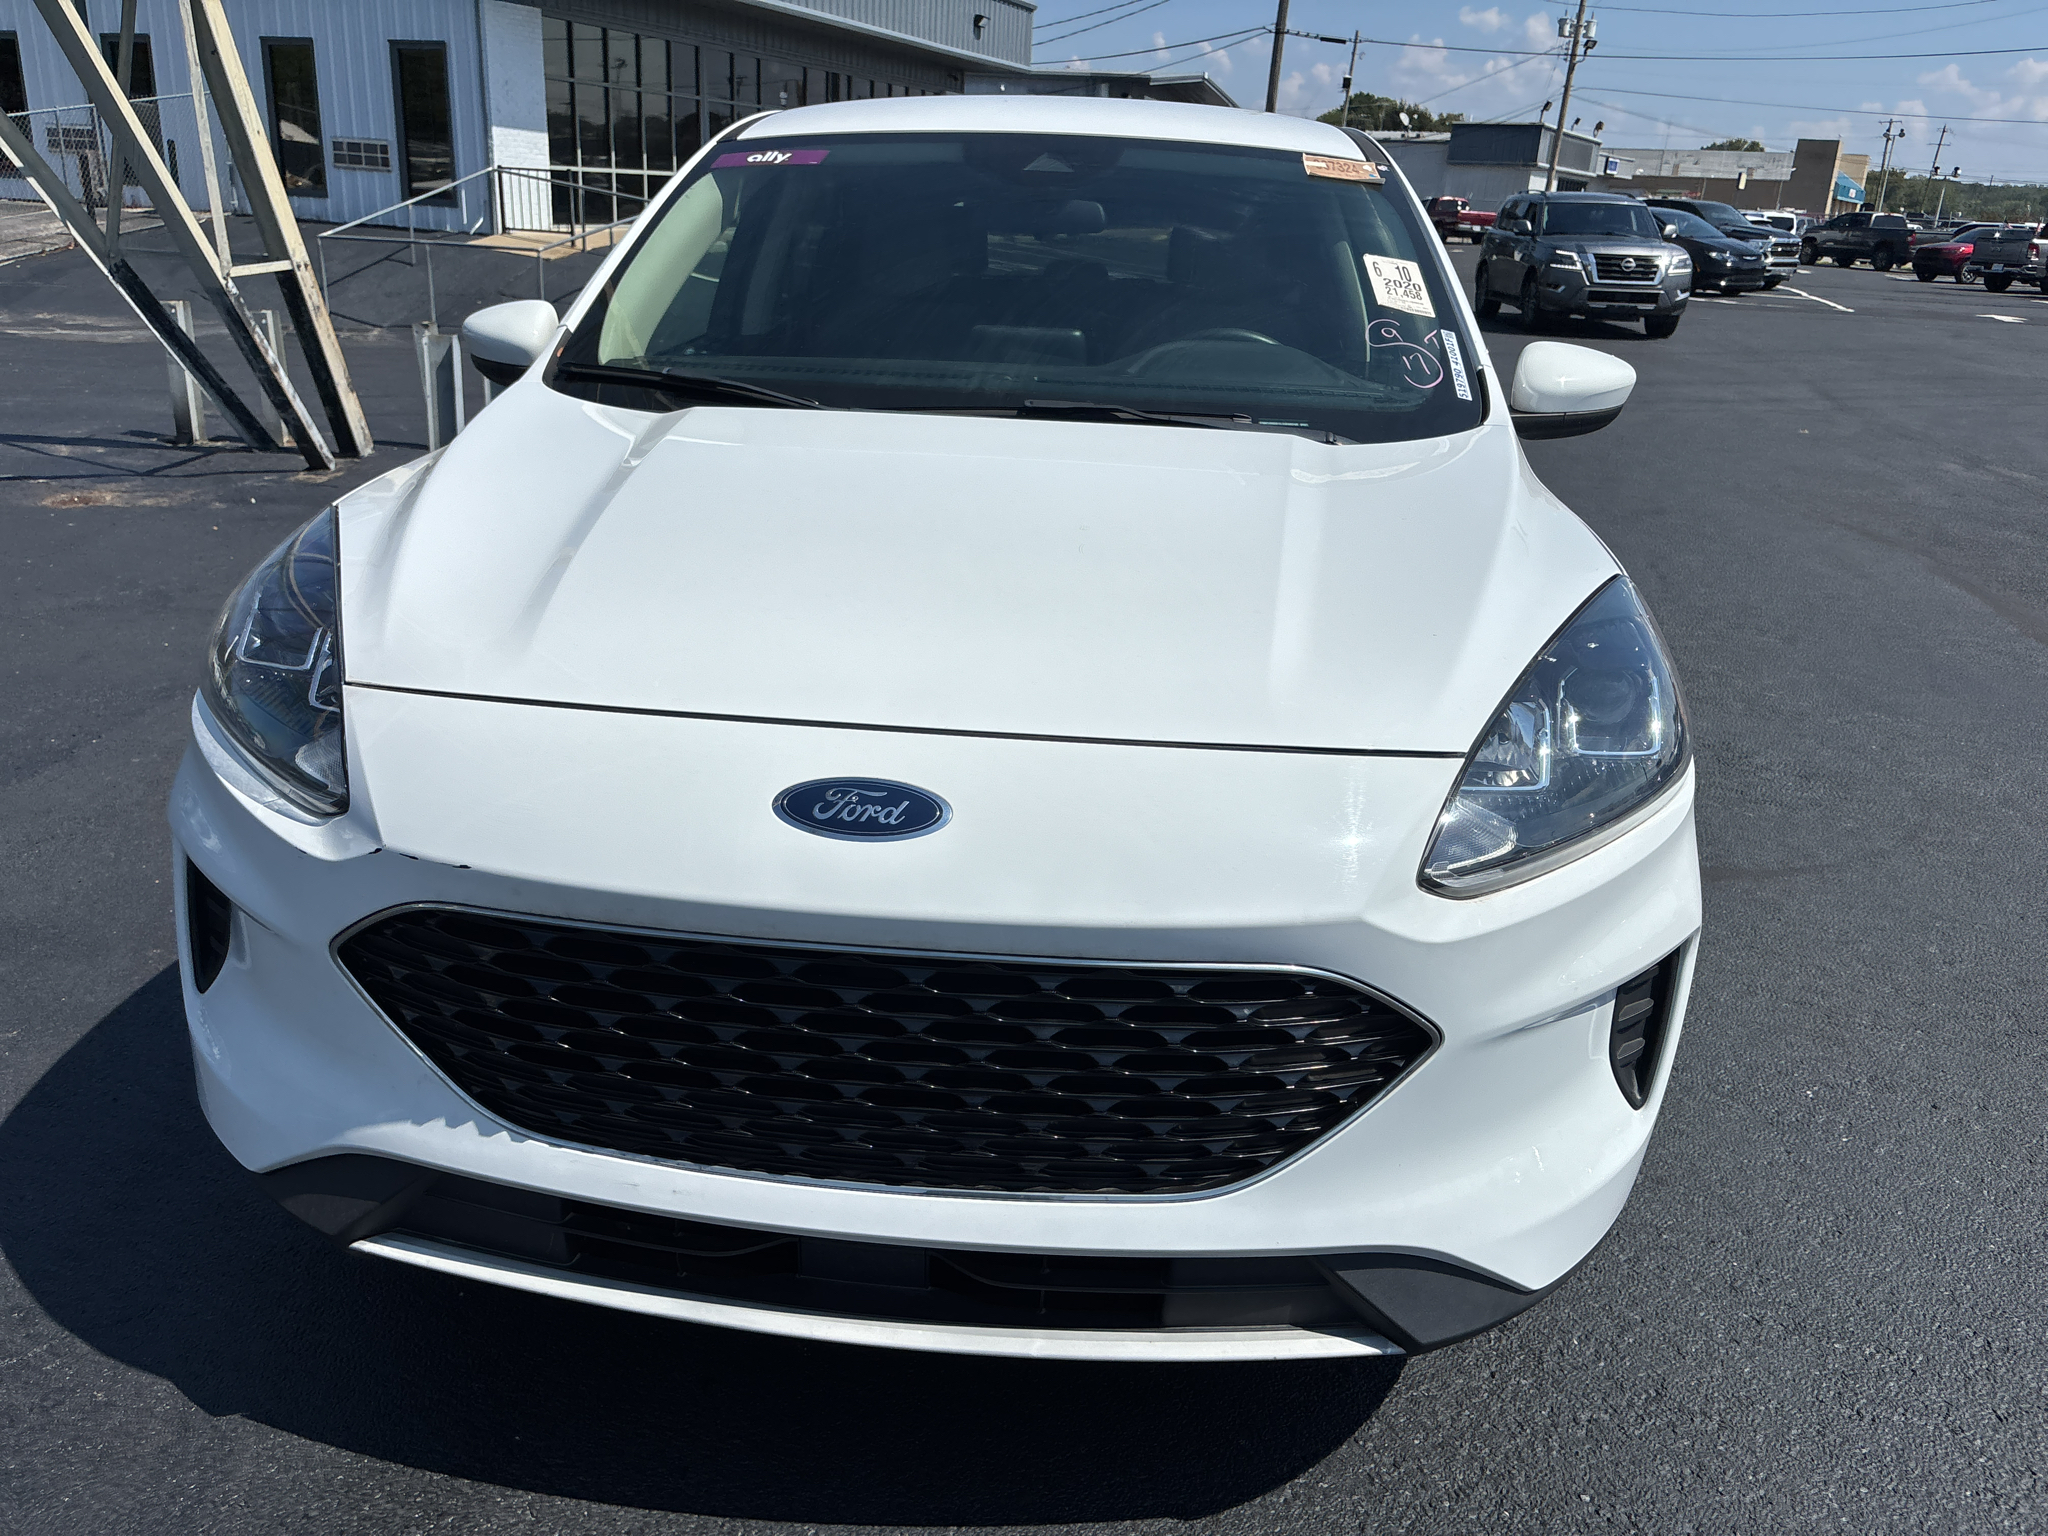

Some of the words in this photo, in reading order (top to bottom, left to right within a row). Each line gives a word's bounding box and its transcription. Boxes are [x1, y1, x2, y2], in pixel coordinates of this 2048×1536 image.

[746, 151, 792, 164] ally
[1372, 261, 1383, 277] 6
[1394, 265, 1412, 282] 10
[1382, 277, 1422, 292] 2020
[1384, 286, 1423, 301] 21,458
[812, 787, 910, 825] Ford
